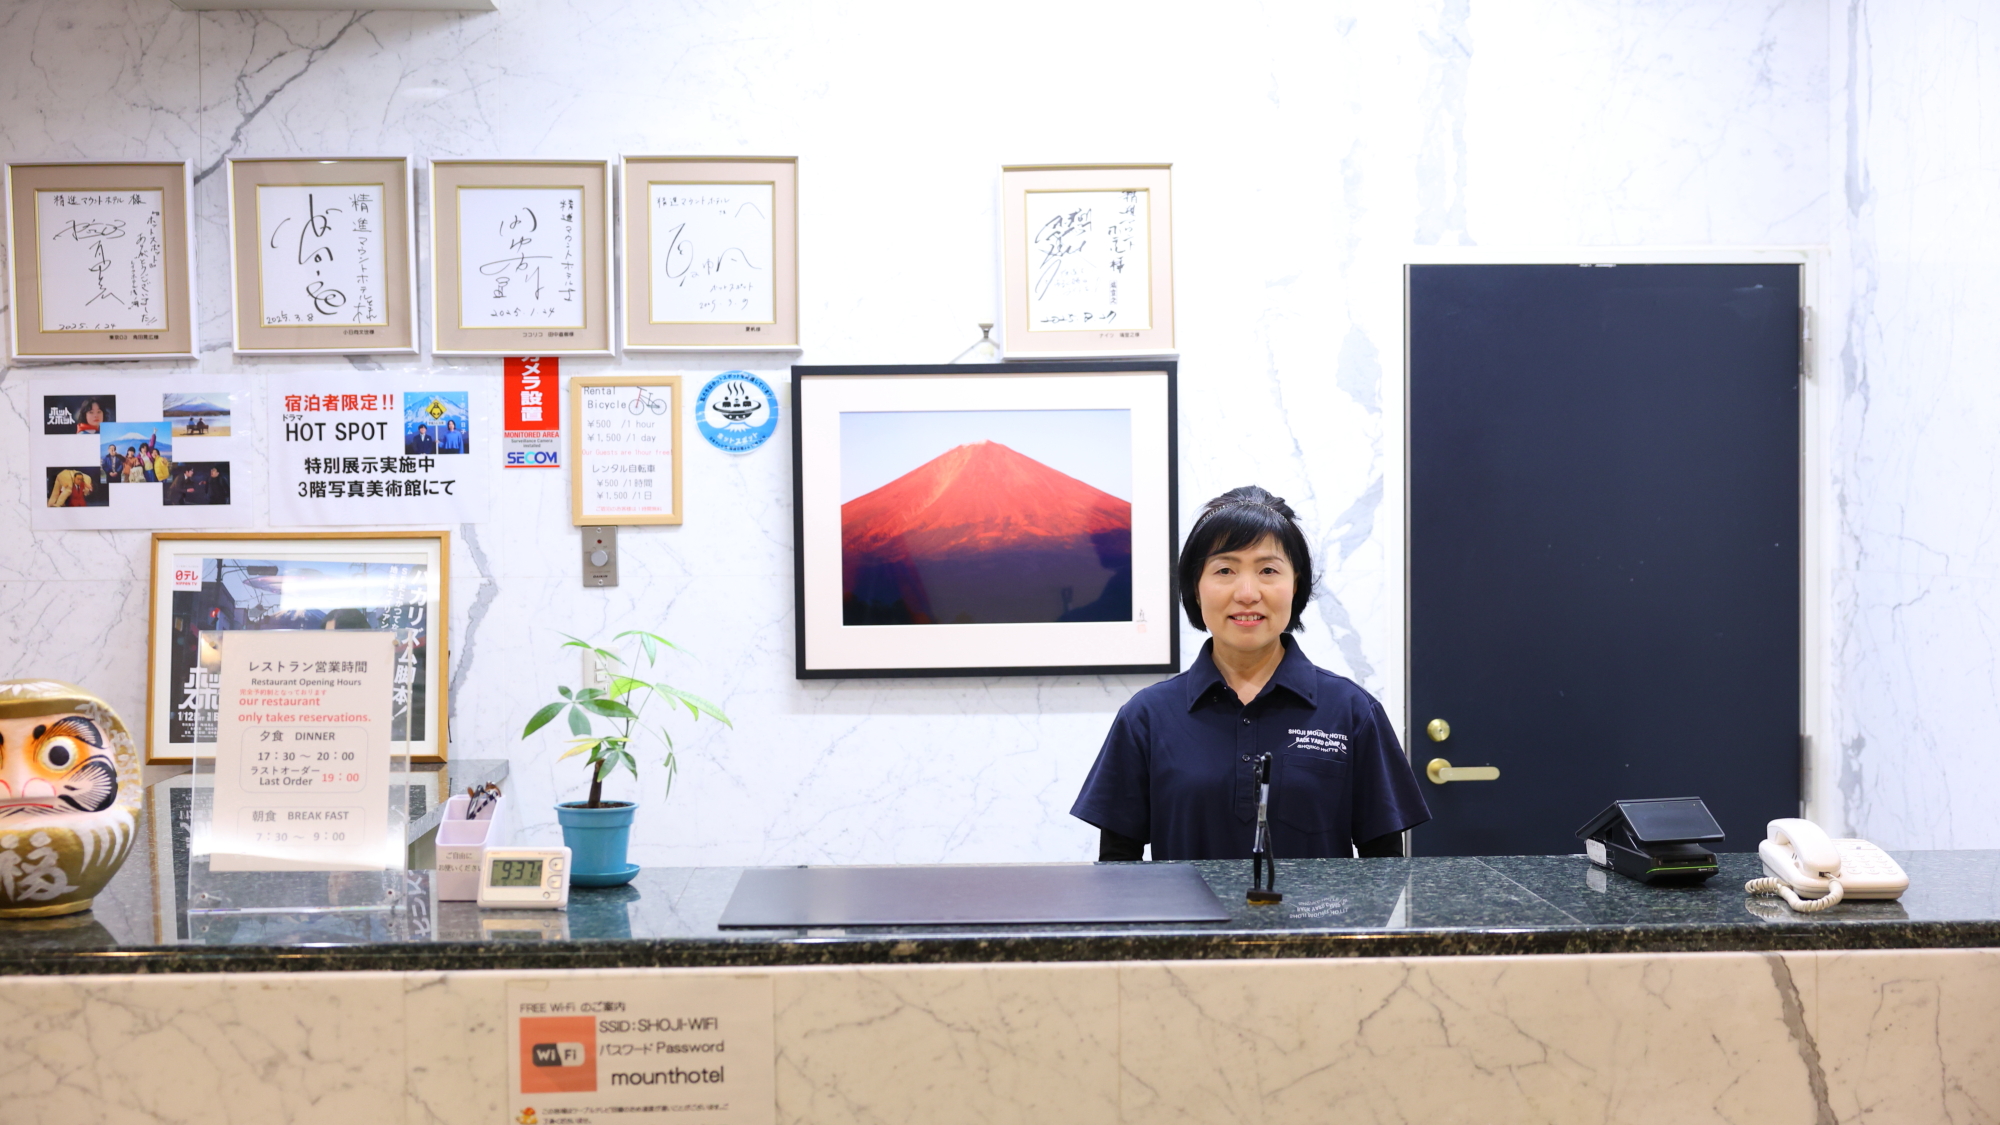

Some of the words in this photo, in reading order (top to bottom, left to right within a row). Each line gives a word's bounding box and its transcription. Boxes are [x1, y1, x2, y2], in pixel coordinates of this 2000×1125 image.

[583, 386, 616, 395] Rental
[284, 393, 395, 412] 宿泊者限定!!
[587, 399, 627, 410] Bicycle
[282, 414, 303, 422] ドラマ
[635, 419, 655, 428] hour
[286, 422, 326, 442] HOT
[335, 421, 388, 441] SPOT
[641, 433, 656, 443] day
[507, 451, 557, 464] SECOM
[304, 455, 435, 474] 特別展示実施中
[592, 464, 656, 473] レンタル自転車
[298, 479, 456, 498] 3階写真美術館にて
[175, 570, 198, 581] 日テレ
[249, 661, 368, 673] レストラン営業時間
[184, 667, 219, 688] ホッ
[251, 678, 297, 686] Restaurant
[299, 678, 335, 687] Opening
[337, 678, 362, 686] Hours
[178, 688, 219, 710] スポ
[239, 698, 259, 706] our
[261, 697, 321, 706] restaurant
[238, 712, 263, 724] only
[265, 712, 296, 722] takes
[299, 712, 371, 722] reservations.
[259, 730, 284, 742] 夕食
[294, 732, 336, 741] DINNER
[1307, 730, 1329, 739] MOUNT
[1329, 733, 1348, 741] HOTEL
[1310, 737, 1324, 746] YARD
[250, 766, 321, 775] ラストオーダー
[259, 777, 280, 786] Last
[283, 777, 313, 786] Order
[252, 810, 277, 823] 朝食
[287, 811, 322, 821] BREAK
[324, 811, 350, 820] FAST
[519, 1003, 547, 1013] FREE
[550, 1002, 576, 1012] Wi-Fi
[580, 1001, 626, 1013] のご案内
[599, 1042, 654, 1056] パスワード
[656, 1040, 724, 1055] Password
[611, 1066, 724, 1086] mounthotel
